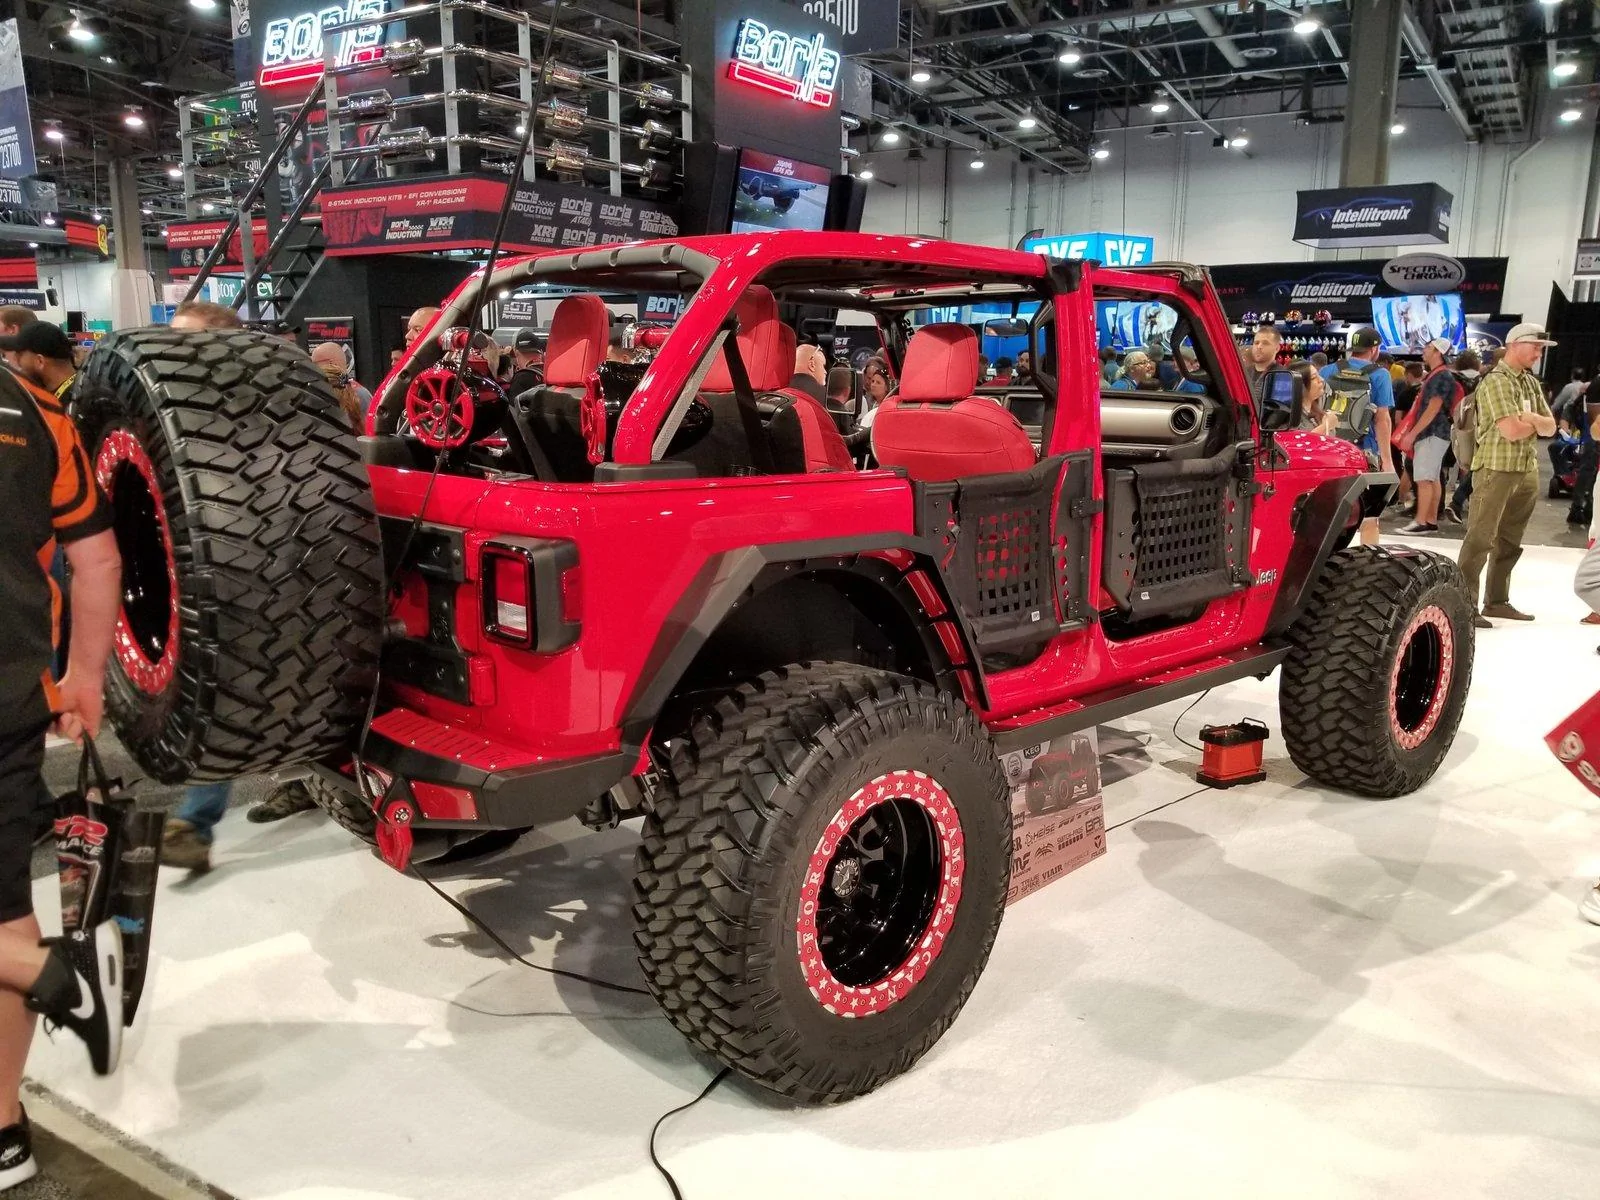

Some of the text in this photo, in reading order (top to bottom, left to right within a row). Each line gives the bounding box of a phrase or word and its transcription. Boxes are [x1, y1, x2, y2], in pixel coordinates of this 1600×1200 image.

[353, 196, 387, 205] INDUCTION
[419, 188, 468, 198] CONVERSIONS
[510, 203, 554, 216] NDUCTION
[1332, 205, 1411, 223] Intellitronix
[385, 229, 423, 240] INDUCTION
[1104, 239, 1147, 267] CVF
[1388, 264, 1449, 274] SPECTRA
[1290, 281, 1375, 297] Intellitronix
[502, 313, 532, 321] Performance
[1024, 745, 1041, 757] KEG
[1042, 864, 1063, 880] VIAIR
